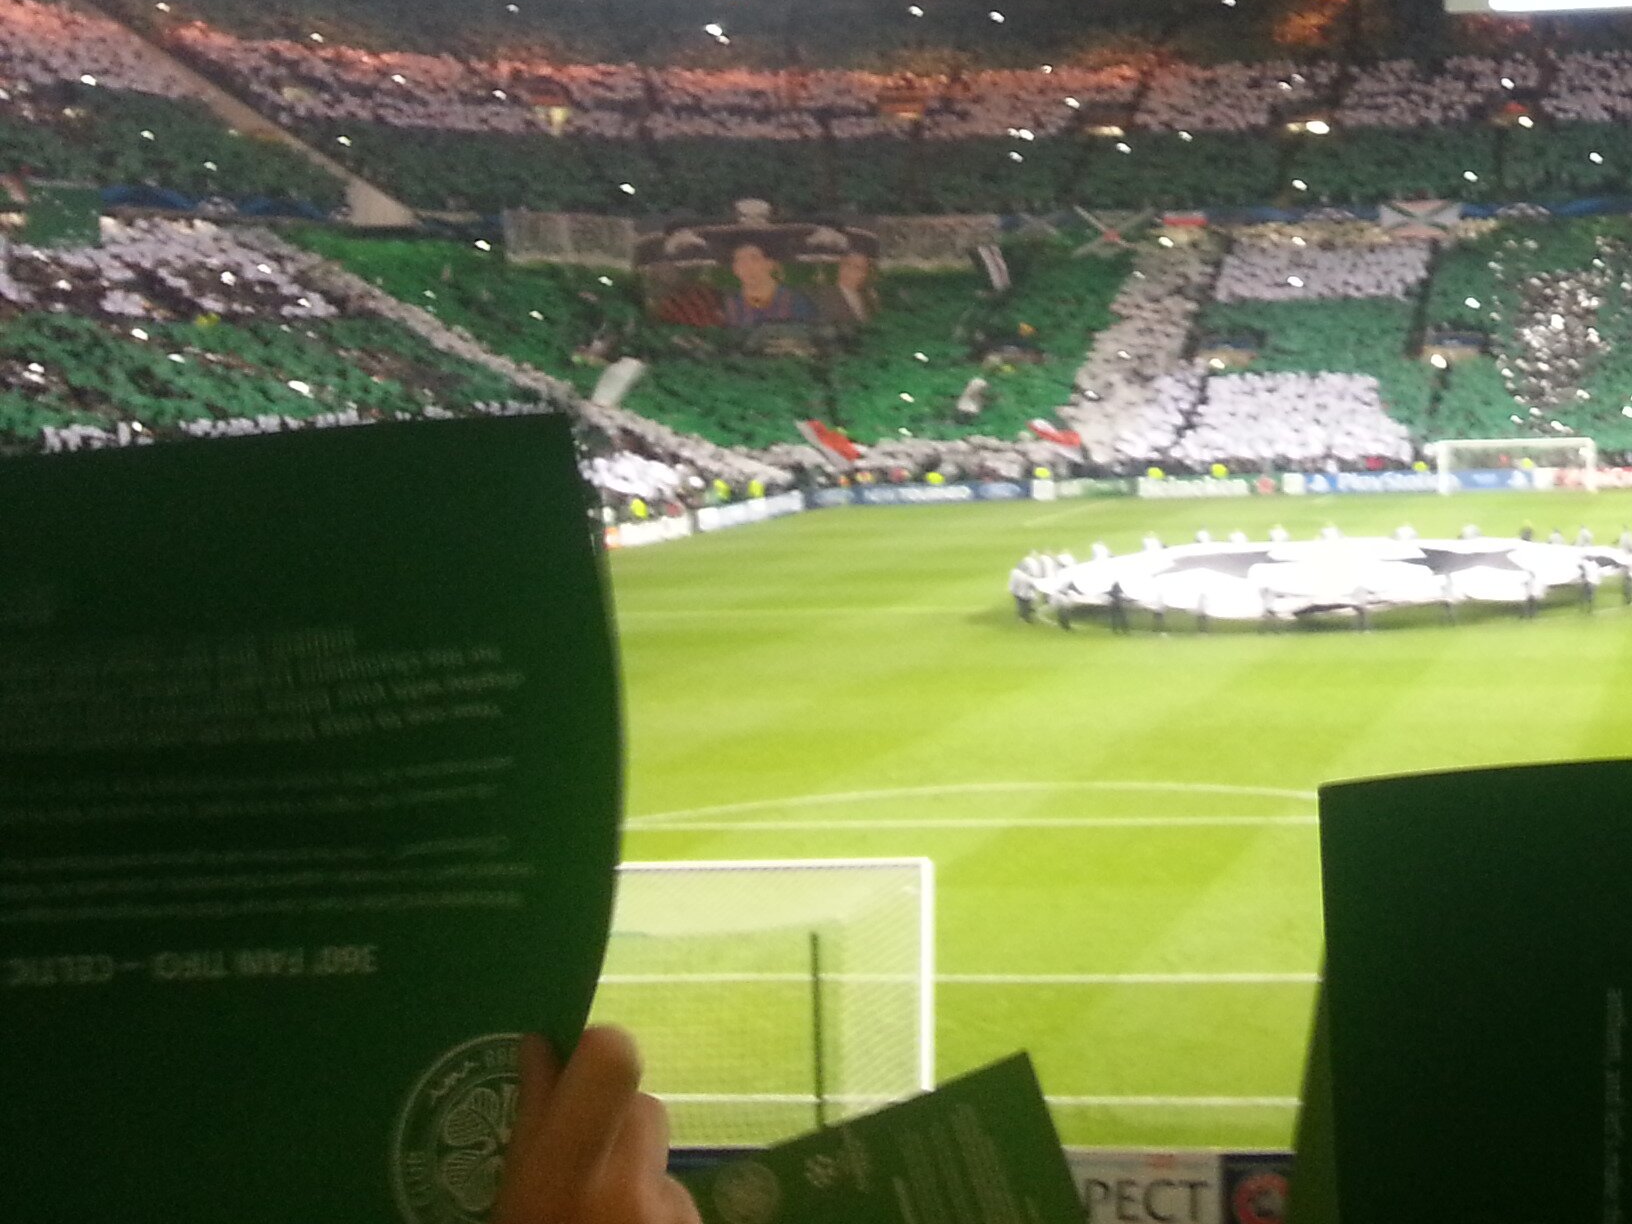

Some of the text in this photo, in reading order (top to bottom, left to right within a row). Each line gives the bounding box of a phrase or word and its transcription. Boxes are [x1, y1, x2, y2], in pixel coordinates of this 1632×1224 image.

[8, 954, 114, 985] CELTIC
[151, 949, 228, 981] TIFO
[235, 947, 304, 977] FAN
[1084, 1178, 1209, 1222] PECT
